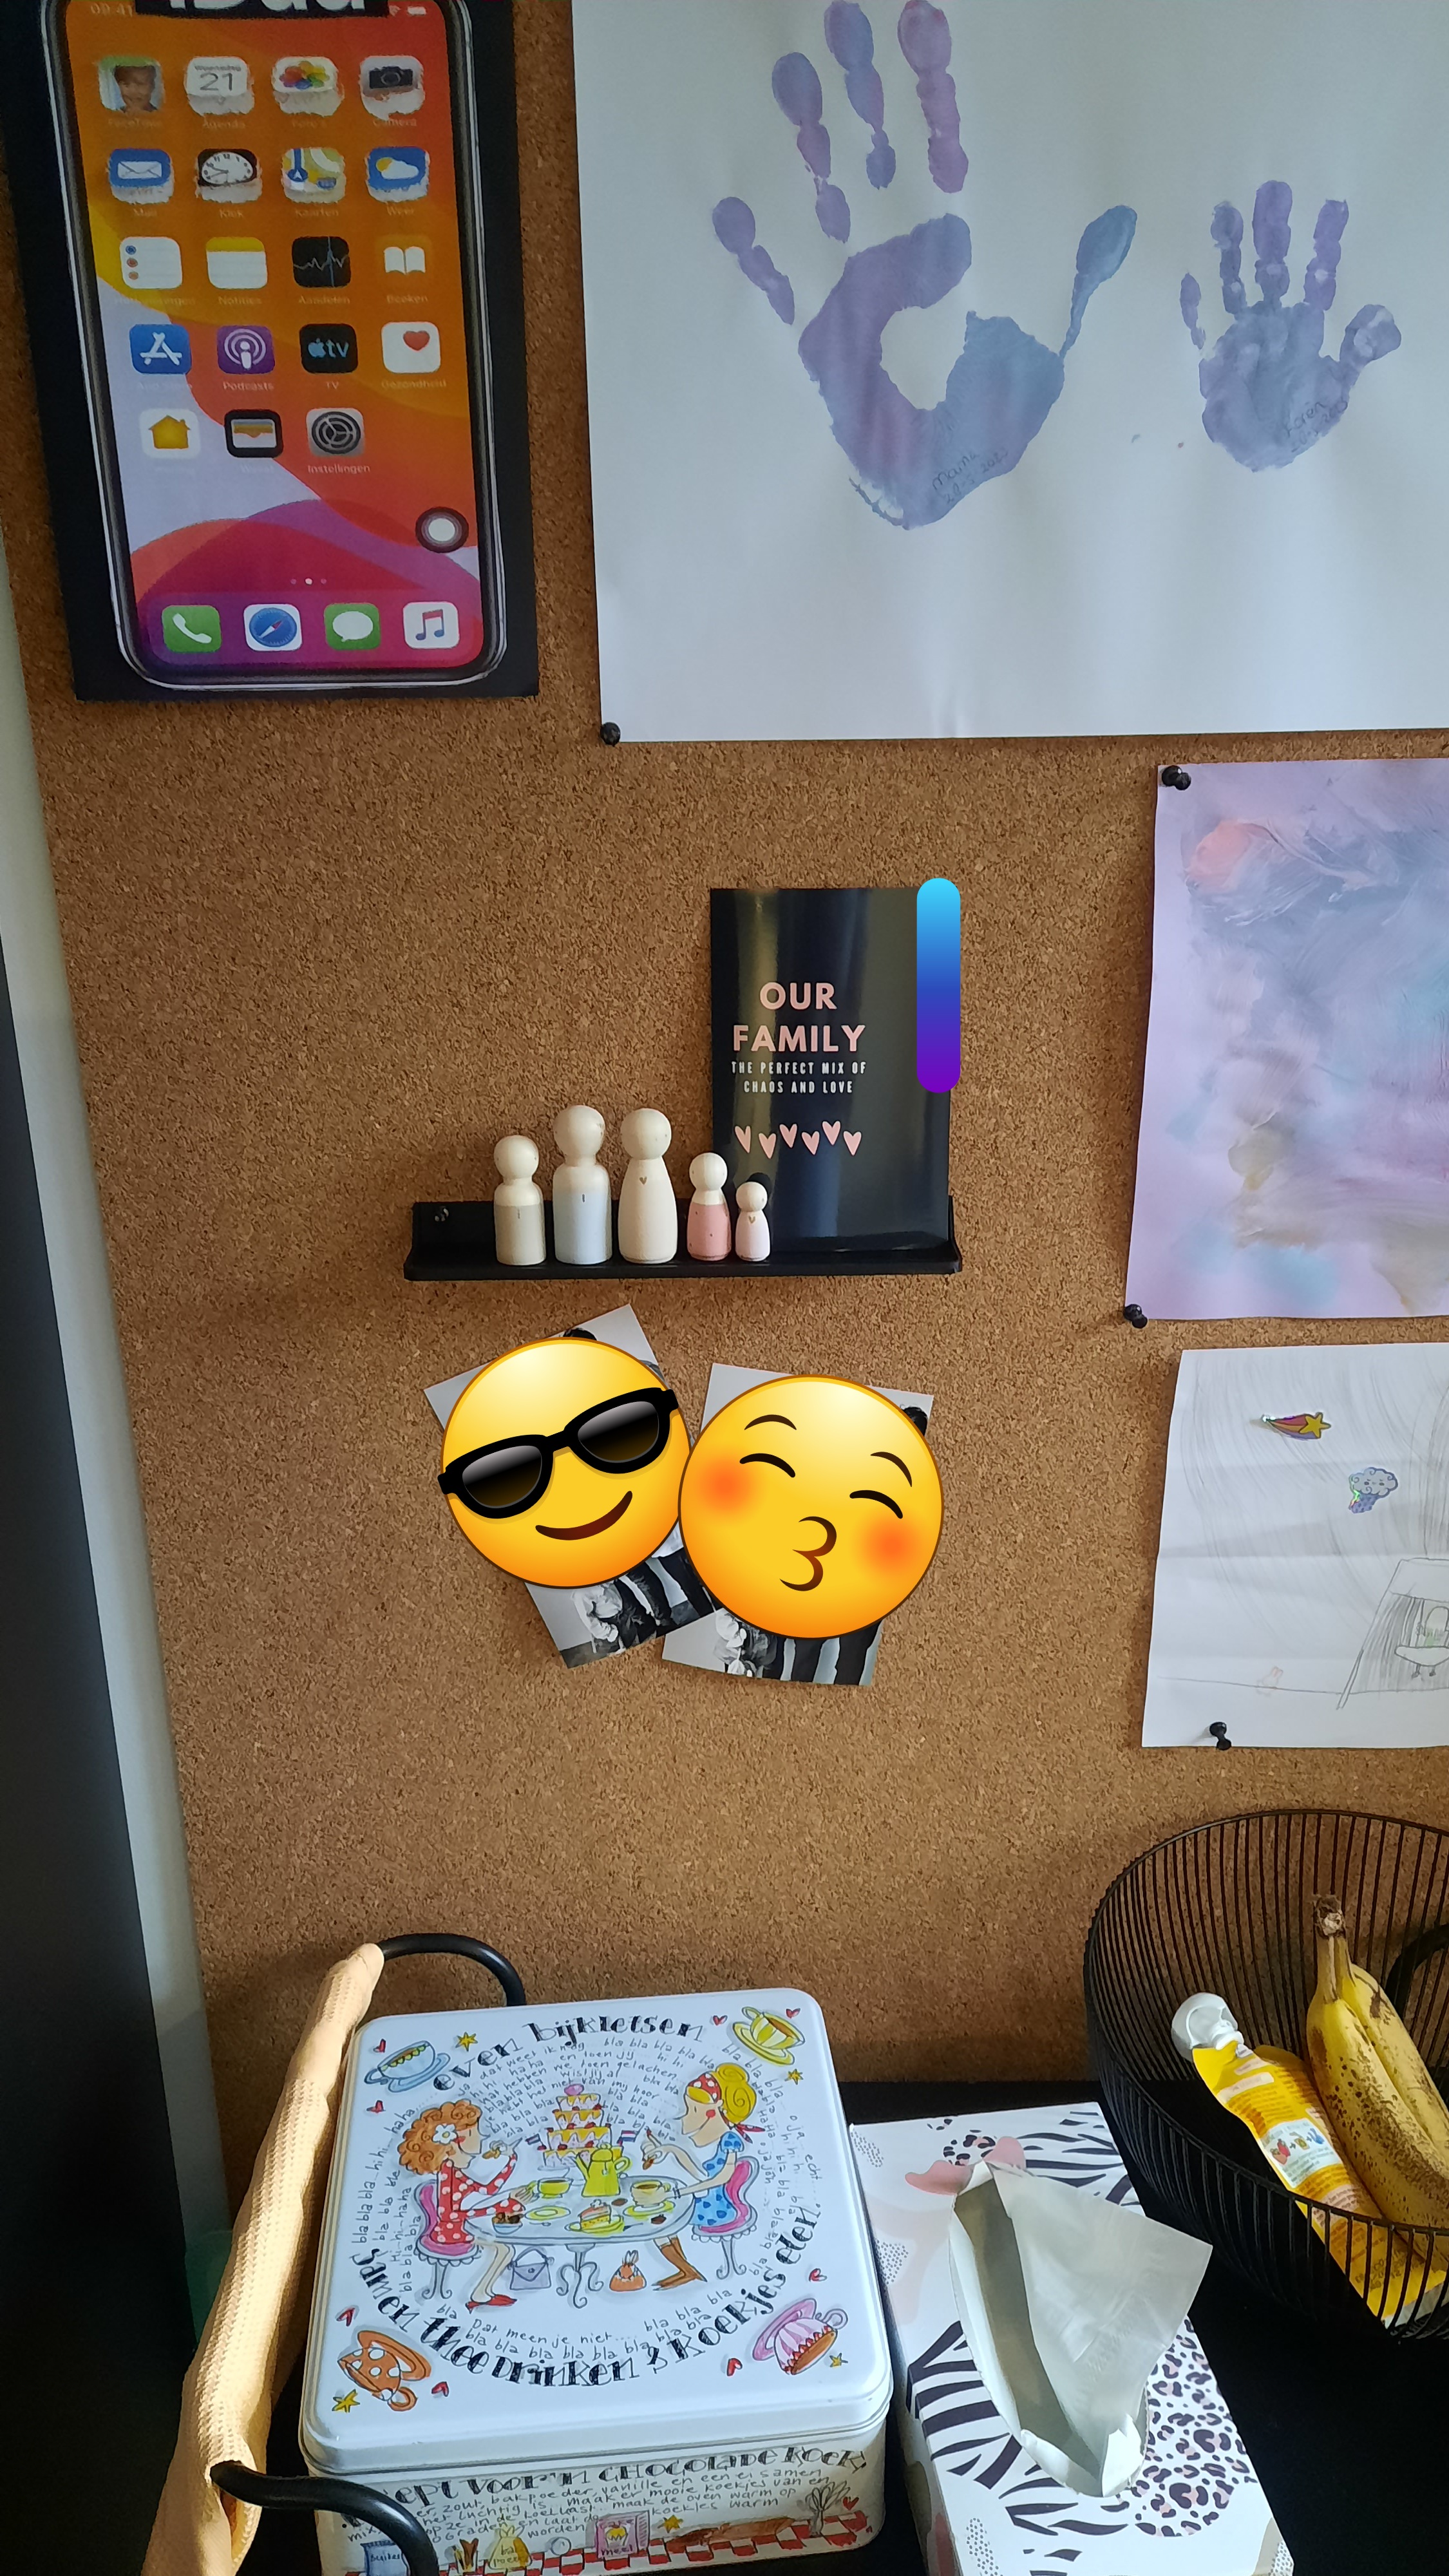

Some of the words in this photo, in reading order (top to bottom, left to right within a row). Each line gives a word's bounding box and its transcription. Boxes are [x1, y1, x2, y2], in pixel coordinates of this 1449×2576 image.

[199, 71, 234, 92] 21
[372, 117, 417, 128] Camera
[294, 208, 340, 218] Kaarten
[386, 205, 415, 216] Weer
[218, 296, 263, 305] Notities
[325, 339, 350, 358] tv
[223, 381, 275, 391] Podcasts
[327, 381, 340, 390] TV
[307, 464, 372, 475] Instellingen
[759, 981, 837, 1010] OUR
[733, 1024, 866, 1053] FAMILY
[731, 1061, 753, 1074] THE
[760, 1061, 815, 1075] PERFECT
[821, 1061, 844, 1075] MIX
[851, 1061, 867, 1075] OF
[743, 1081, 784, 1094] CHAOS
[791, 1081, 815, 1094] AND
[822, 1080, 853, 1094] LOVE
[433, 2038, 523, 2090] even
[522, 2014, 705, 2048] bijkletsen
[480, 2063, 503, 2080] dat
[506, 2050, 536, 2068] weet
[544, 2045, 556, 2054] ik
[603, 2037, 623, 2047] bla
[629, 2037, 649, 2049] bla
[654, 2039, 673, 2052] bla
[677, 2045, 696, 2060] bla
[560, 2052, 577, 2061] en
[502, 2067, 548, 2091] hebben
[553, 2061, 573, 2071] we
[581, 2058, 609, 2068] toen
[616, 2060, 678, 2079] gelachen
[643, 2074, 661, 2086] bla
[721, 2043, 742, 2062] bla
[744, 2058, 763, 2079] bla
[764, 2078, 784, 2100] bla
[527, 2086, 547, 2101] het
[551, 2076, 574, 2089] niet
[582, 2077, 606, 2087] van
[633, 2083, 661, 2099] hoor
[511, 2110, 532, 2121] bla
[533, 2099, 555, 2110] bla
[607, 2086, 623, 2101] bla
[629, 2094, 649, 2107] bla
[526, 2116, 549, 2127] bla
[627, 2106, 645, 2121] bla
[606, 2114, 626, 2125] bla
[777, 2179, 790, 2198] bla
[404, 2215, 421, 2237] bla
[399, 2244, 413, 2266] bla
[398, 2270, 413, 2293] bla
[350, 2248, 420, 2333] samen
[420, 2317, 490, 2374] thee
[491, 2354, 640, 2387] drinken
[662, 2266, 786, 2364] koekjes
[436, 2304, 458, 2319] bla
[472, 2318, 498, 2333] Dat
[506, 2328, 547, 2344] meen
[551, 2333, 569, 2349] je
[643, 2318, 669, 2331] bla
[675, 2306, 701, 2320] bla
[706, 2289, 732, 2305] bla
[465, 2327, 487, 2346] bla
[495, 2338, 519, 2354] bla
[529, 2345, 554, 2360] bla
[562, 2345, 585, 2359] bla
[592, 2345, 618, 2362] bla
[623, 2338, 650, 2354] bla
[655, 2329, 682, 2343] bla
[686, 2314, 712, 2330] bla
[601, 2479, 662, 2496] vanille
[671, 2477, 693, 2487] en
[700, 2472, 730, 2482] een
[738, 2470, 754, 2479] ei
[759, 2468, 822, 2479] samen
[422, 2514, 451, 2526] het
[459, 2505, 522, 2520] luchtig
[620, 2491, 643, 2499] er
[649, 2486, 698, 2499] mooie
[705, 2479, 767, 2495] koekjes
[773, 2477, 802, 2487] van
[809, 2474, 831, 2485] en
[446, 2522, 466, 2531] ze
[475, 2516, 491, 2527] in
[497, 2511, 517, 2524] de
[612, 2498, 654, 2509] maak
[661, 2497, 681, 2505] de
[687, 2492, 721, 2502] oven
[730, 2488, 773, 2499] warm
[779, 2485, 797, 2498] op
[518, 2516, 539, 2528] en
[729, 2499, 779, 2508] warm
[527, 2524, 585, 2539] worden
